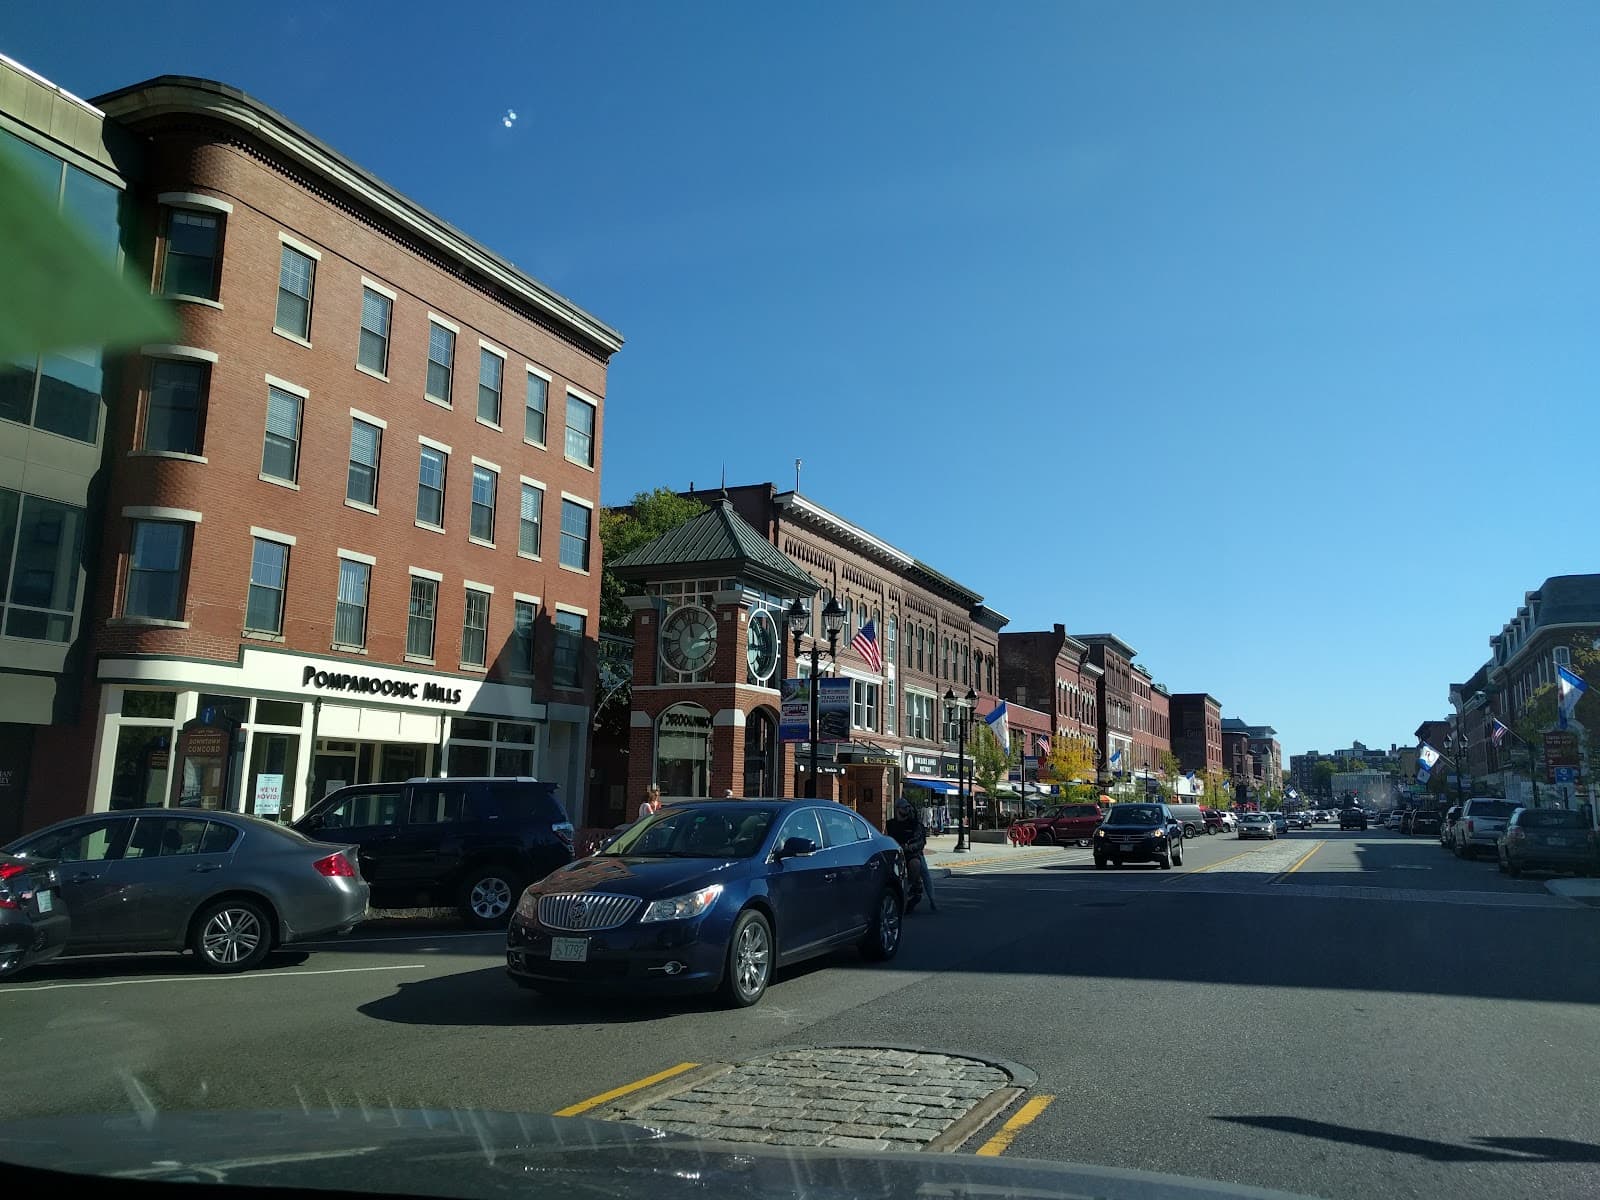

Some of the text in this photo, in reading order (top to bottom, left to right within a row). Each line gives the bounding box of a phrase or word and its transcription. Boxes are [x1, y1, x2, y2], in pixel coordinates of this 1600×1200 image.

[302, 666, 462, 704] POMPANOOSUC MILLS
[188, 745, 221, 753] CONCORD
